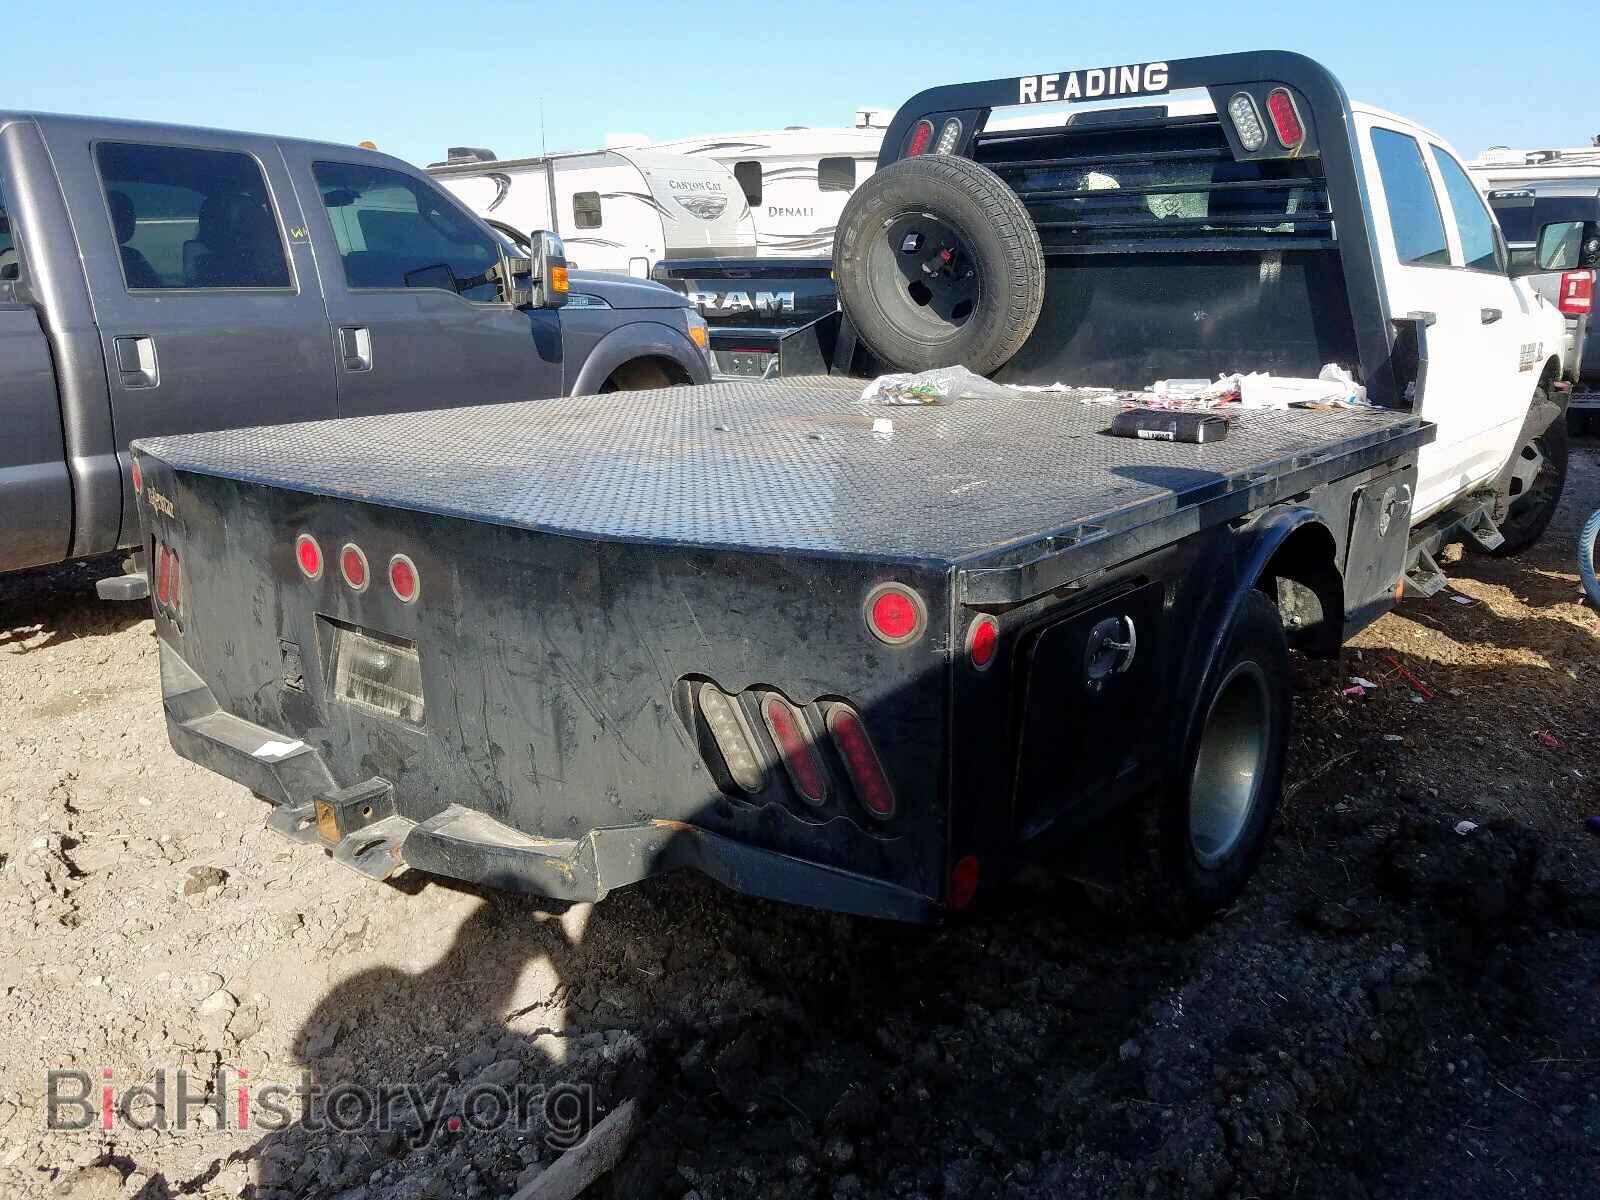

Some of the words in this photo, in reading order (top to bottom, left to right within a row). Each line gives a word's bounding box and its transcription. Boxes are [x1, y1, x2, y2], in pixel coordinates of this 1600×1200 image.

[1019, 62, 1169, 104] READING
[768, 206, 815, 218] DENALI
[691, 290, 795, 312] RAM
